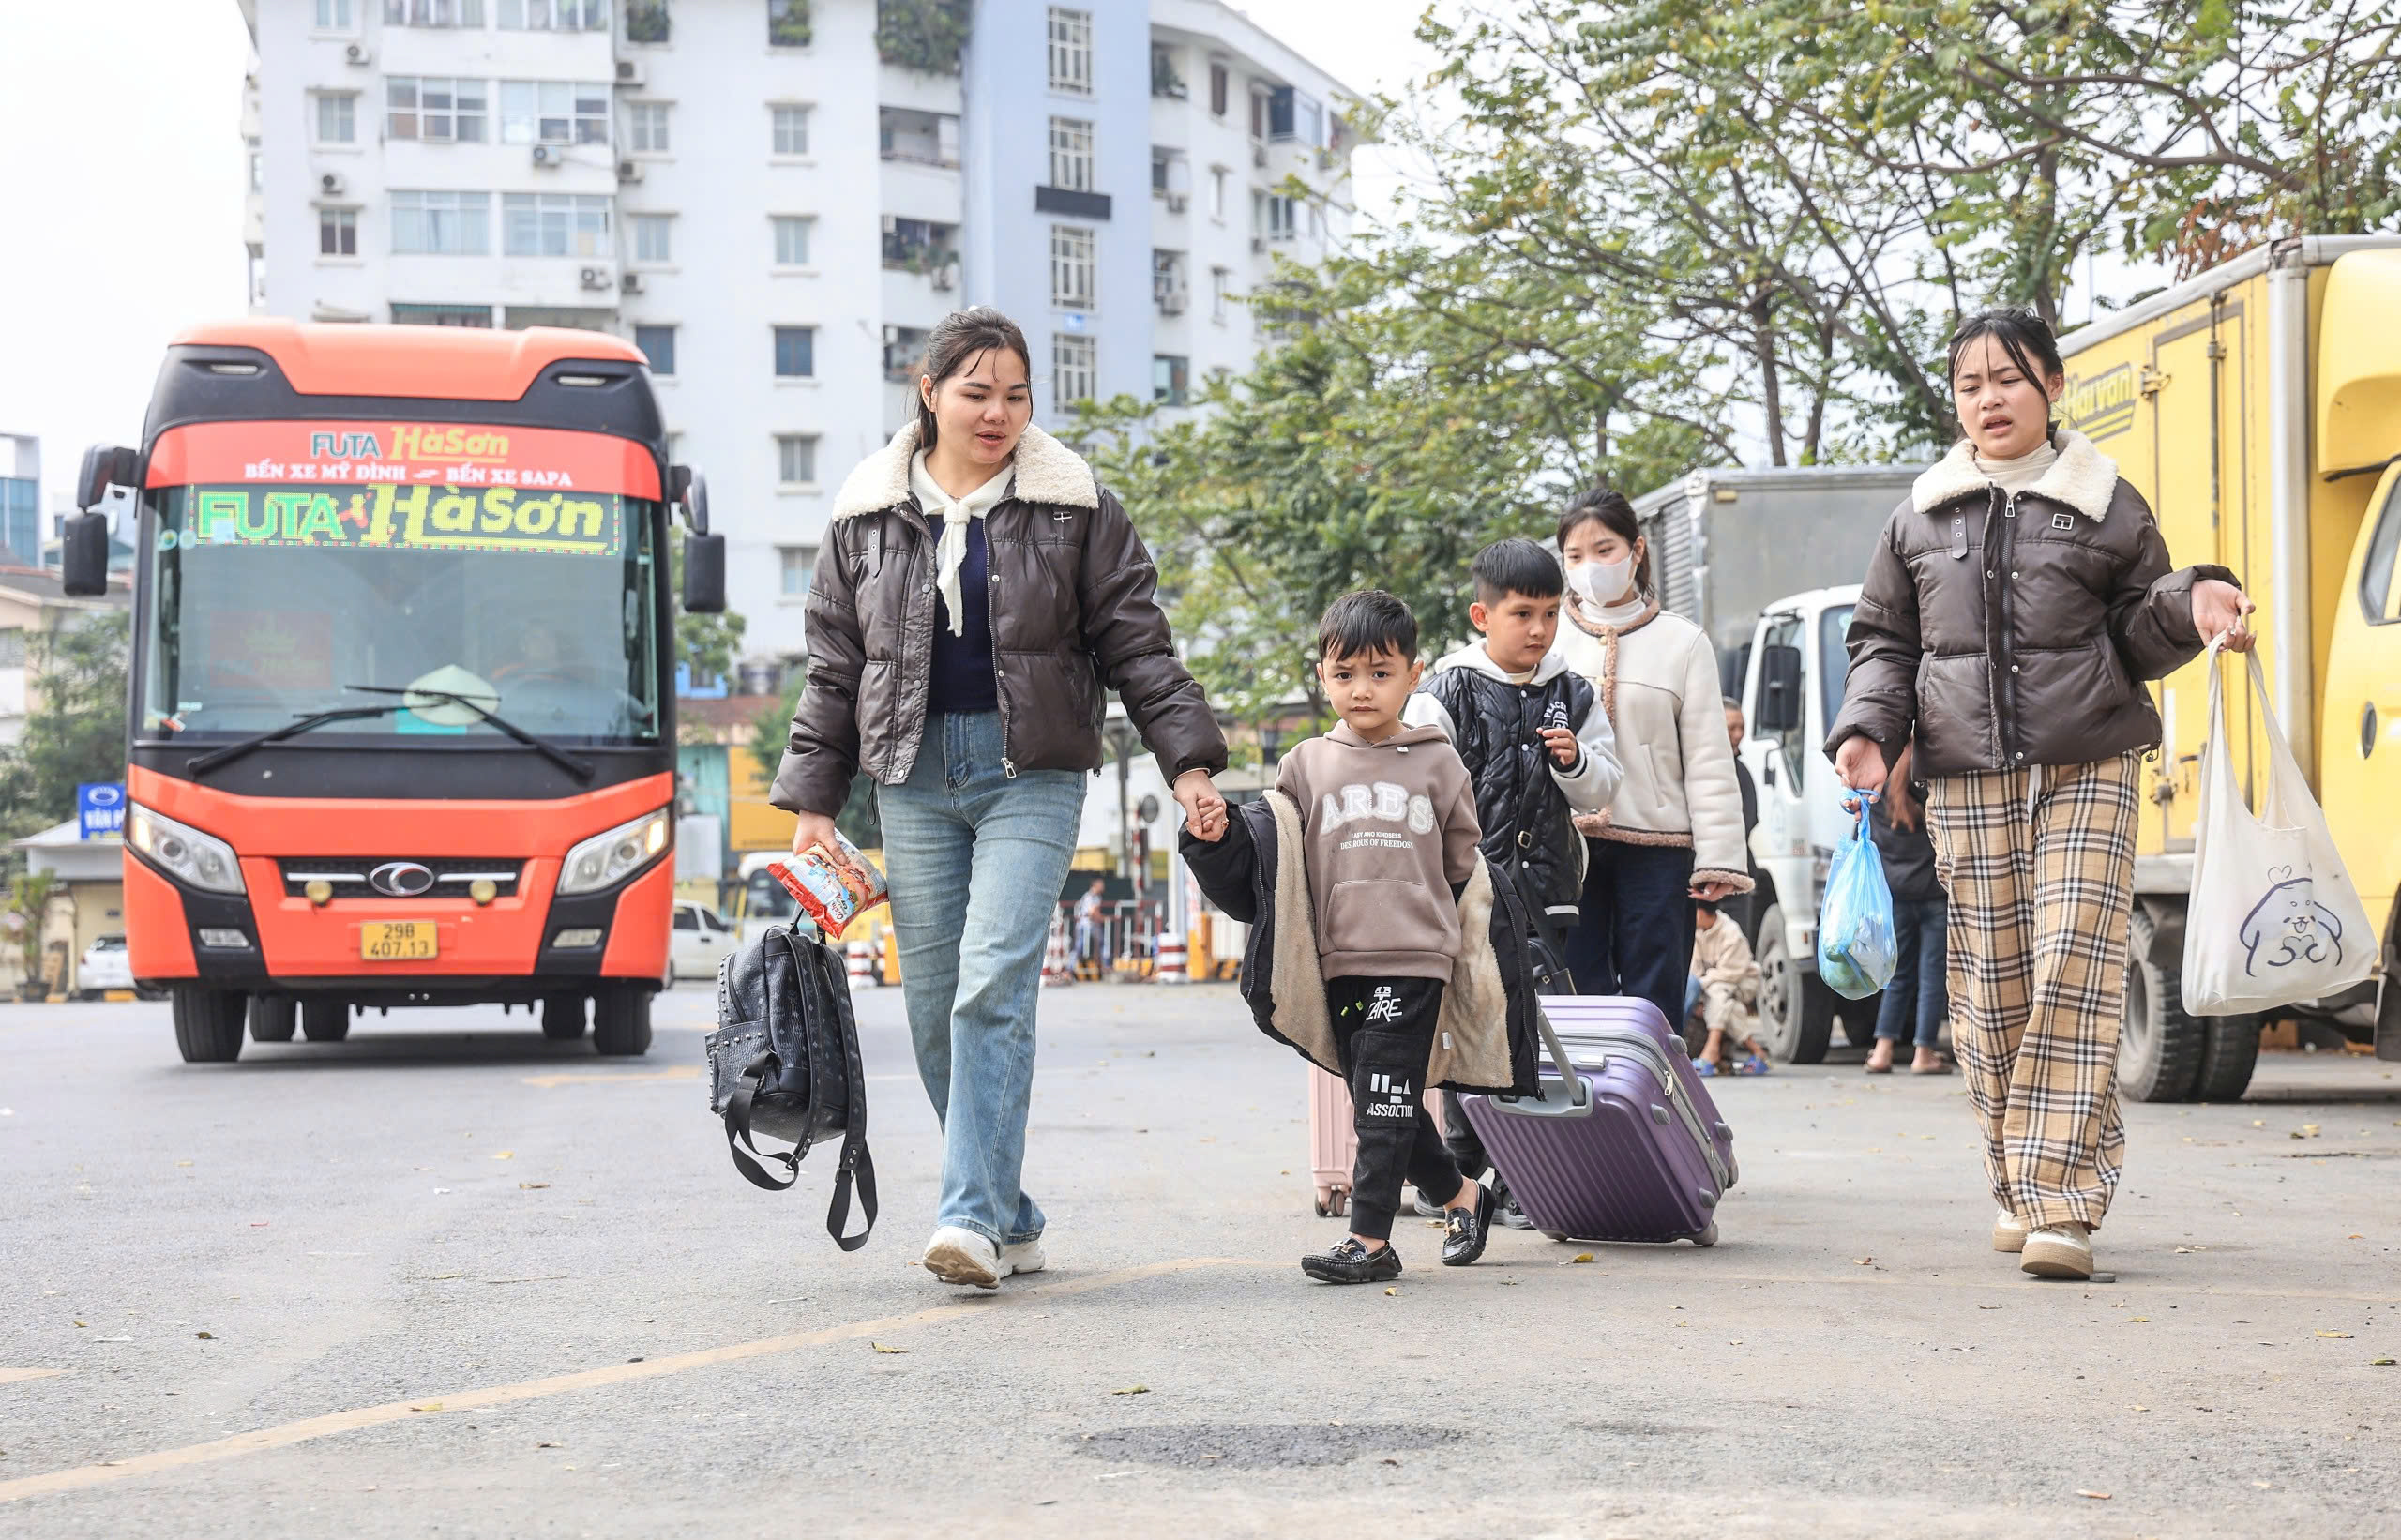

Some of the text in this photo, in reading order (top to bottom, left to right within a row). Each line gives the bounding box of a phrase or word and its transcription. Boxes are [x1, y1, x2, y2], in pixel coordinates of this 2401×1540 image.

[311, 432, 383, 459] FUTA
[245, 458, 285, 479] BẾN
[290, 463, 317, 479] XE
[321, 460, 352, 479] MỸ
[445, 461, 486, 483] BẾN
[490, 469, 517, 484] XE
[521, 470, 573, 487] SAPA
[198, 491, 347, 541] FUTA
[1321, 782, 1433, 834] ARES
